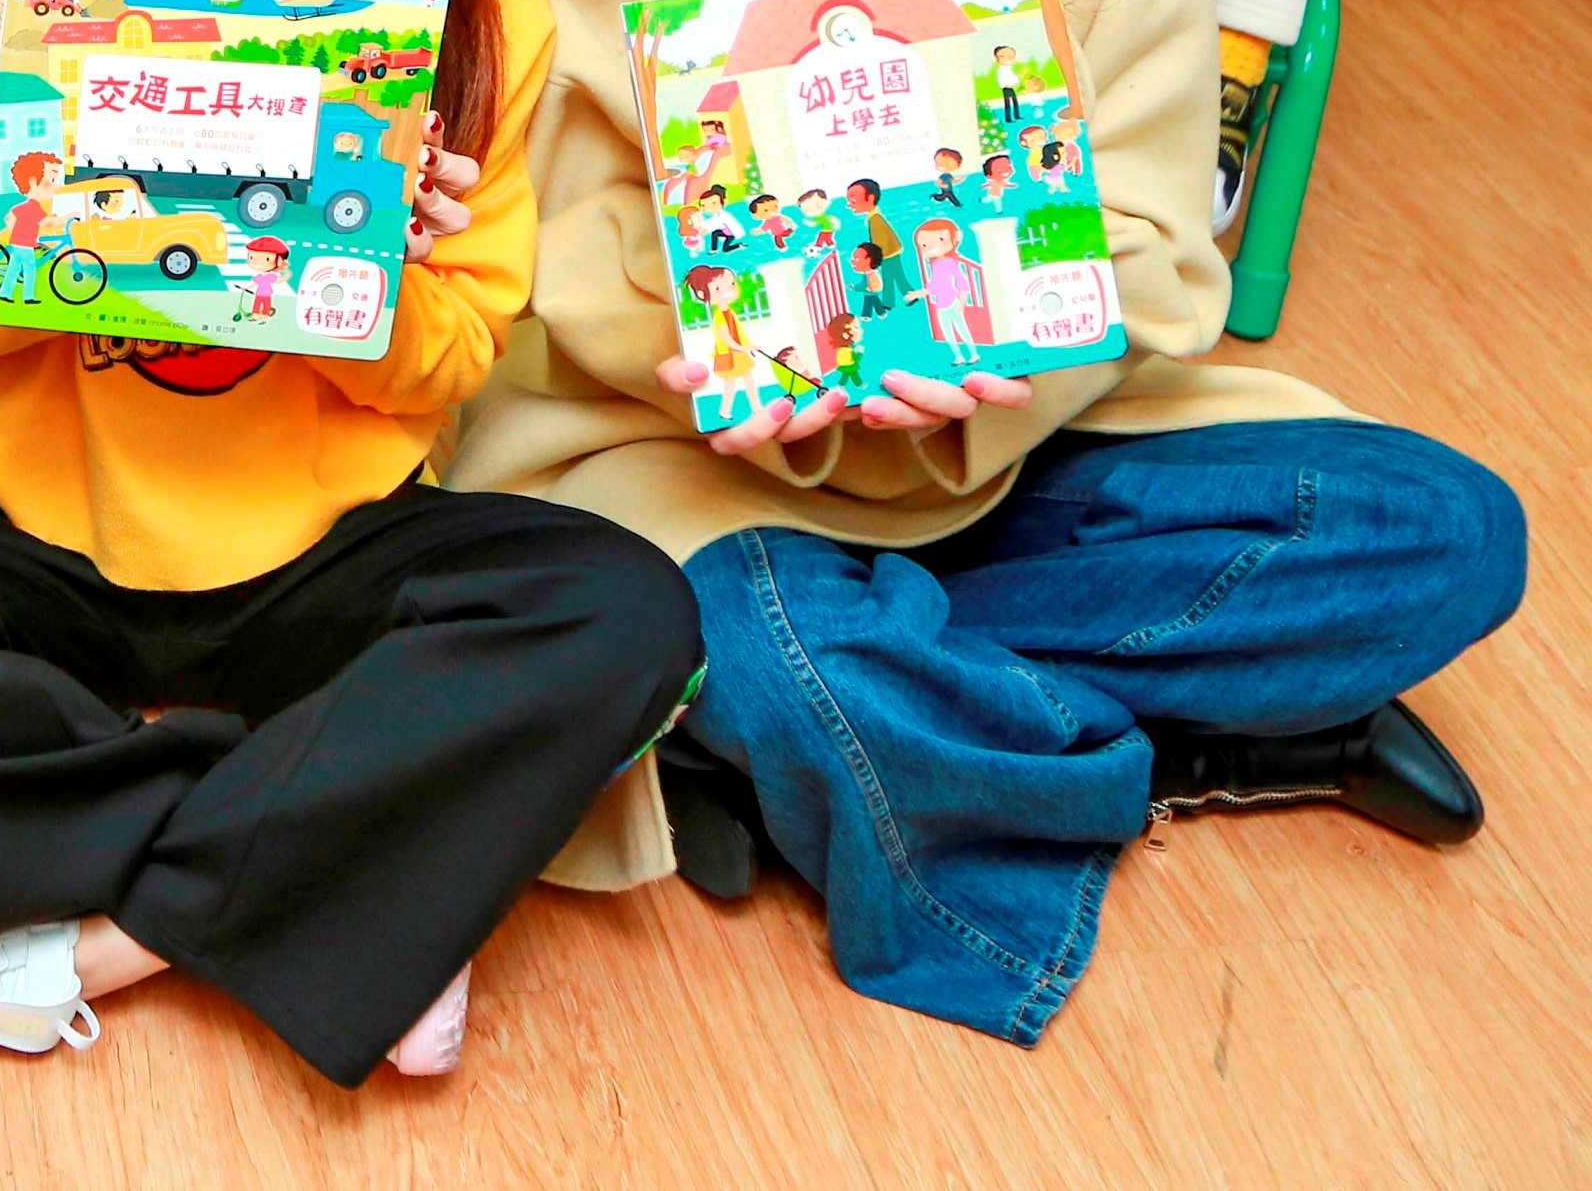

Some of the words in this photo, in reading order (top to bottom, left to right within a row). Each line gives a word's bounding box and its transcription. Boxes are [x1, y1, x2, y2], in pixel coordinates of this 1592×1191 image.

[88, 70, 308, 118] 交通工具大搜查
[799, 58, 910, 113] 幼兒園
[825, 103, 901, 137] 上學去
[304, 306, 367, 330] 有聲書
[1029, 312, 1095, 342] 有聲書
